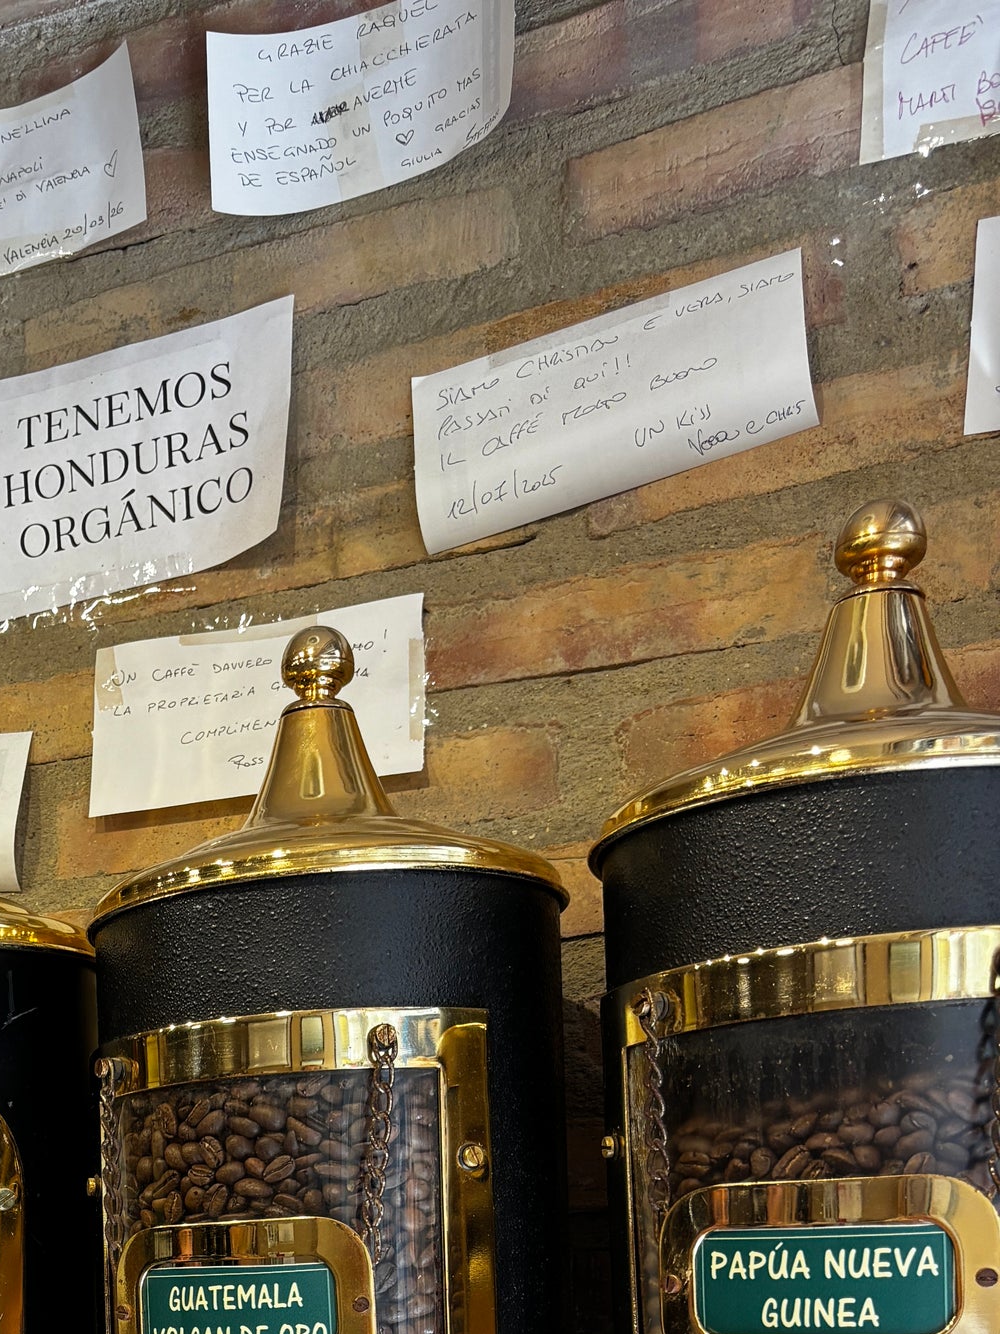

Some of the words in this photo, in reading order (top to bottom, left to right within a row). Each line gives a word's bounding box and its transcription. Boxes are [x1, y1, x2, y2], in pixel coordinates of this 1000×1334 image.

[258, 35, 334, 62] GRAZIE
[356, 0, 439, 39] RAQUEL
[232, 84, 274, 103] PER
[290, 80, 314, 94] LA
[330, 11, 477, 81] CHIACCHIERATA
[231, 136, 337, 164] ENSEGNADO
[352, 124, 370, 137] UN
[383, 88, 447, 128] POQUITO
[456, 68, 481, 92] MAS
[238, 121, 248, 137] Y
[264, 118, 297, 137] POR
[353, 68, 418, 110] AVERME
[238, 172, 262, 188] DE
[276, 153, 356, 186] ESPAÑOL
[434, 98, 481, 133] GRACIAS
[400, 148, 442, 168] GIULIA
[36, 166, 91, 193] VALENCIA
[3, 235, 59, 265] VALENCIA
[643, 315, 662, 331] E
[16, 362, 232, 450] TENEMOS
[634, 421, 665, 448] UN
[3, 411, 249, 509] HONDURAS
[440, 454, 465, 471] IL
[19, 467, 253, 559] ORGÁNICO
[112, 670, 137, 687] UN
[213, 657, 273, 674] DAVVERO
[114, 705, 131, 717] LA
[180, 718, 281, 745] COMPLIMEN
[710, 1242, 811, 1280] PAPÚA
[824, 1246, 939, 1278] NUEVA
[168, 1282, 304, 1312] GUATEMALA
[762, 1298, 880, 1328] GUINEA
